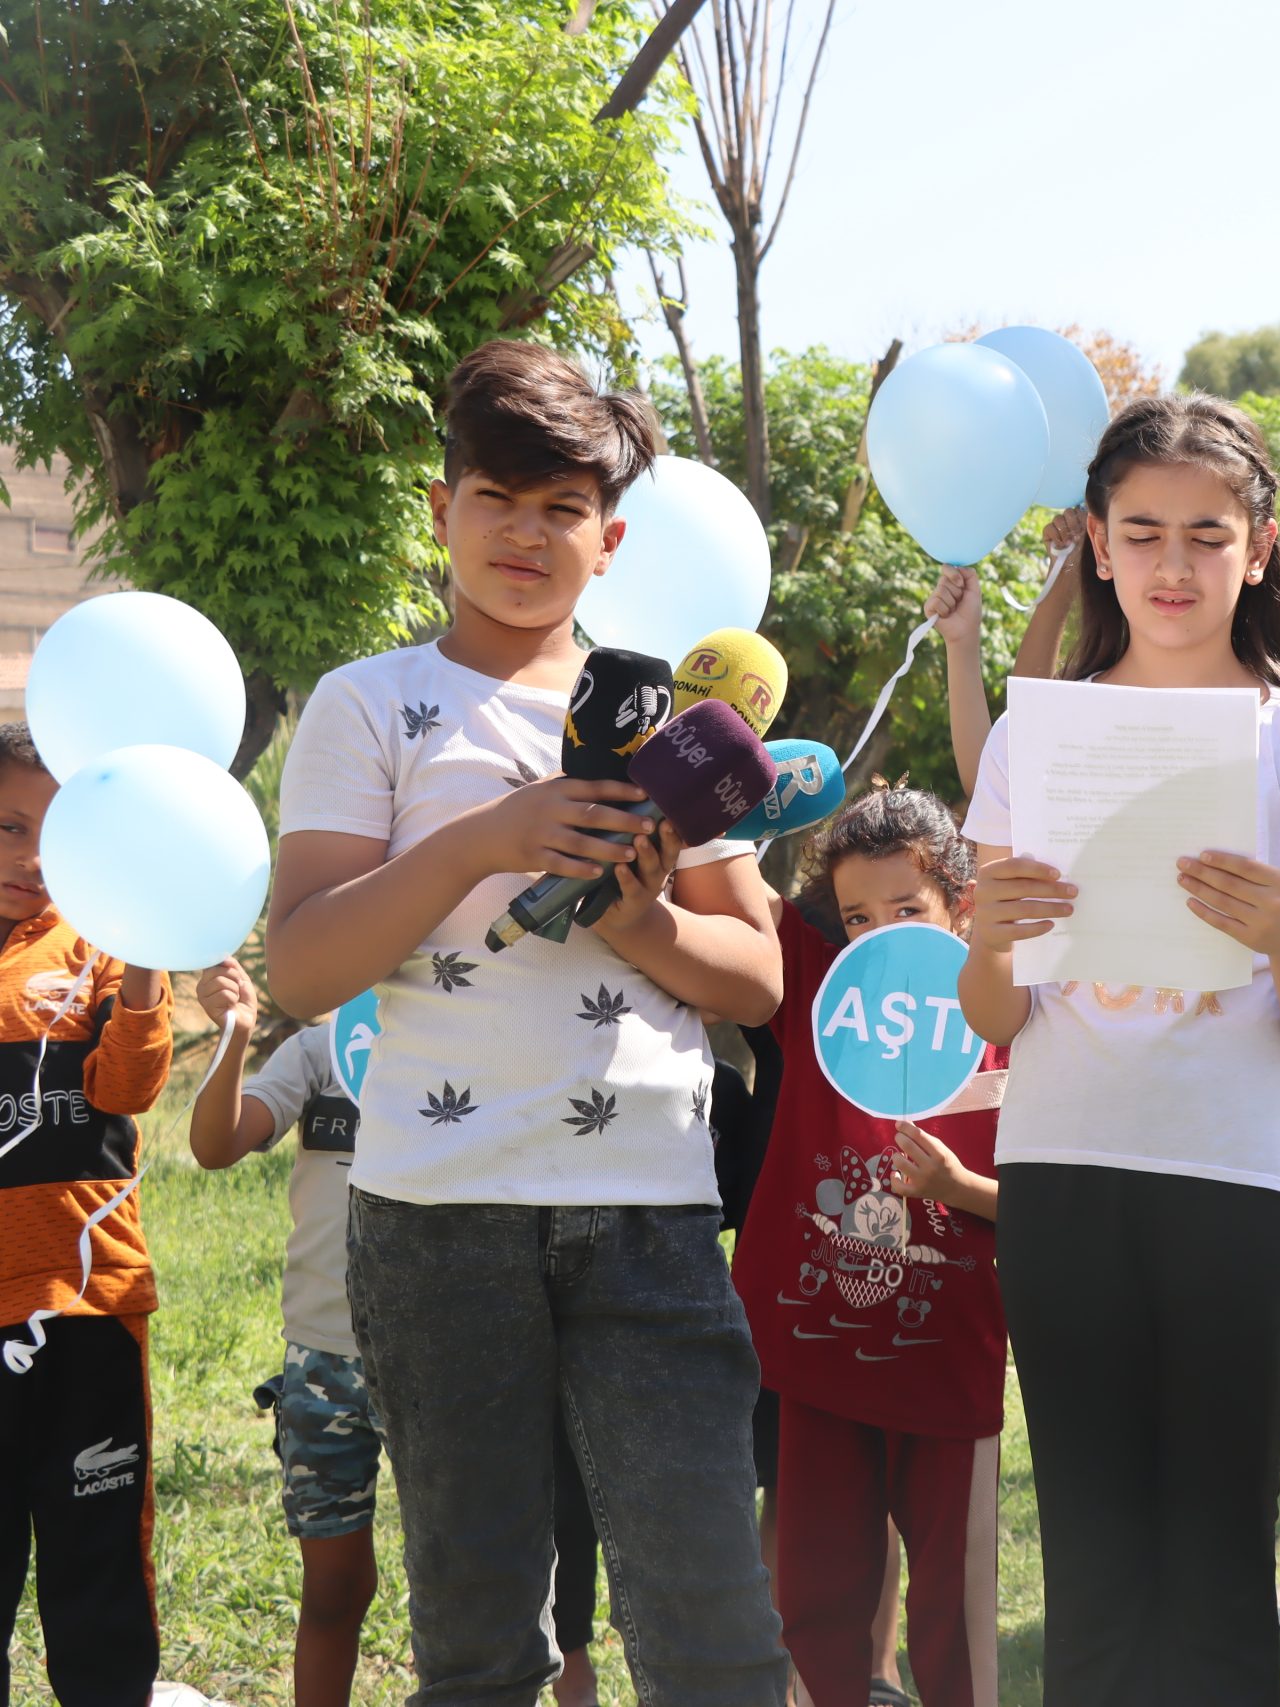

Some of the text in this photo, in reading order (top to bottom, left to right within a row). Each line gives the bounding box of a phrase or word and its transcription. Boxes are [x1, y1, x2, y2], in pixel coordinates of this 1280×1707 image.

[312, 1116, 360, 1137] FR
[866, 1257, 904, 1288] DO
[908, 1268, 934, 1295] IT
[74, 1472, 134, 1496] LACOSTE
